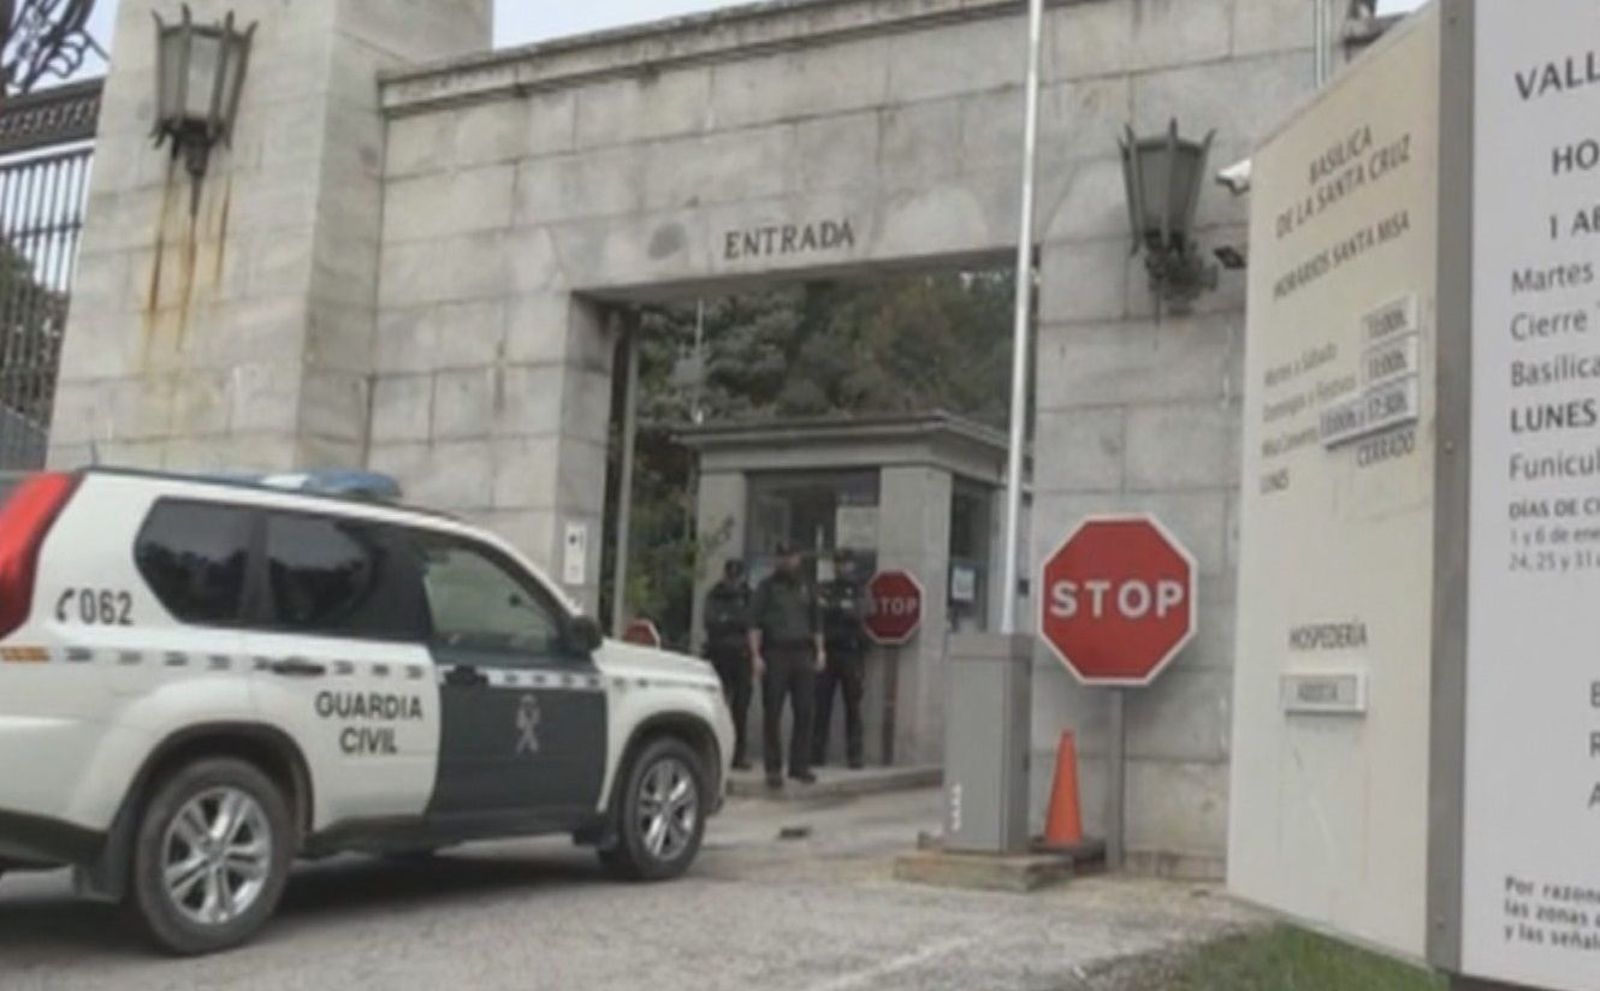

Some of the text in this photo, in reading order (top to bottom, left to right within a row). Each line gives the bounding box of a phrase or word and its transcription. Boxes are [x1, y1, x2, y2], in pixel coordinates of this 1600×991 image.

[1515, 51, 1600, 101] VALL
[1552, 138, 1600, 176] HO
[1297, 197, 1314, 226] LA
[1317, 162, 1365, 214] SANTA
[1369, 132, 1411, 182] CRUZ
[723, 217, 856, 261] ENTRADA
[1332, 227, 1374, 269] SANTA
[1511, 261, 1595, 296] Martes
[1510, 308, 1588, 342] Cierre
[1510, 398, 1598, 434] LUNES
[1356, 428, 1415, 469] CERRADO
[1553, 498, 1578, 518] DE
[80, 586, 134, 627] 062
[869, 596, 918, 617] STOP
[1050, 578, 1185, 620] STOP
[314, 690, 423, 720] GUARDIA
[340, 726, 398, 755] CIVIL
[1504, 876, 1534, 897] Por
[1504, 898, 1529, 918] las
[1537, 905, 1588, 928] zonas
[1504, 924, 1514, 943] y
[1518, 922, 1543, 945] las
